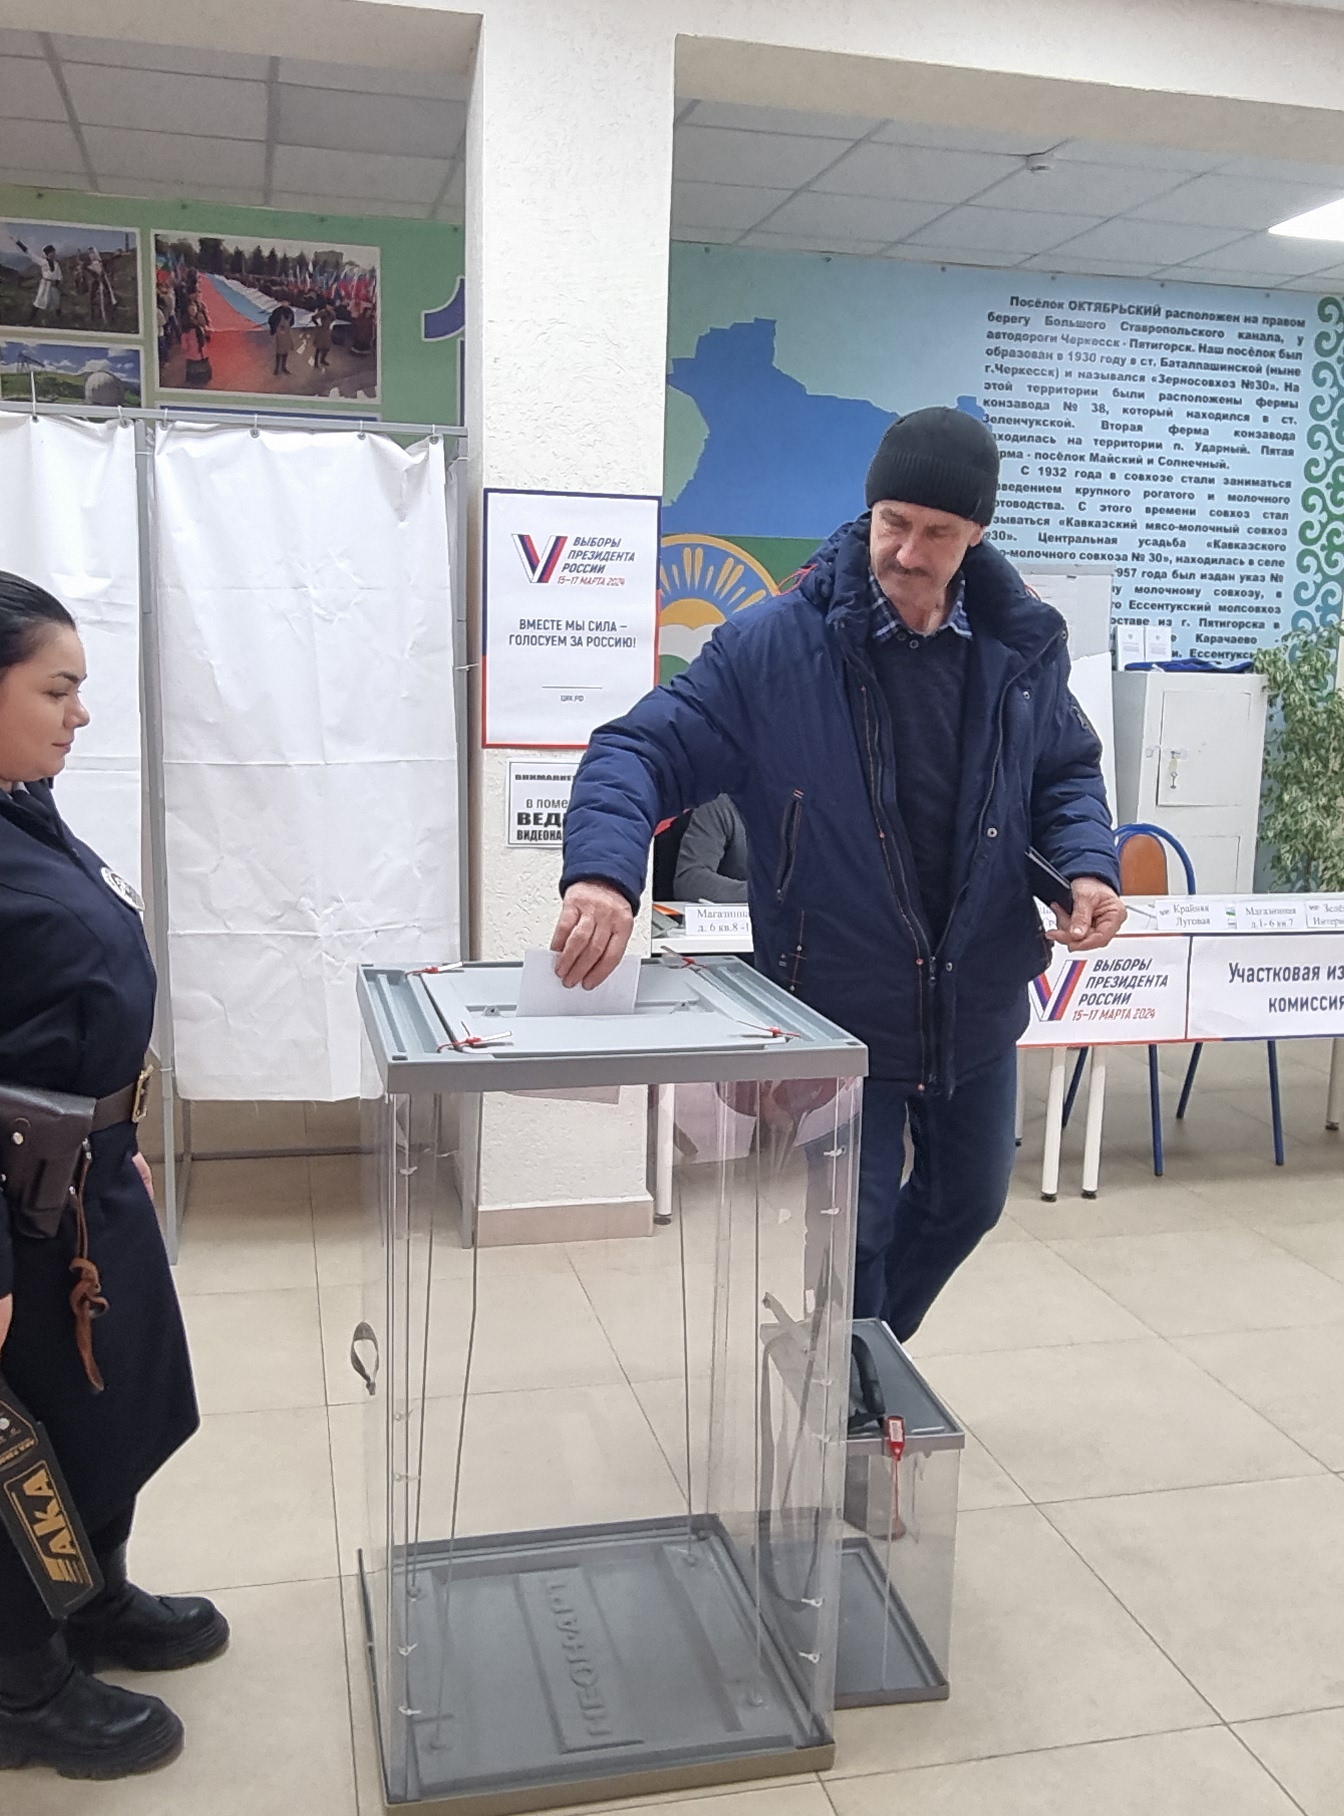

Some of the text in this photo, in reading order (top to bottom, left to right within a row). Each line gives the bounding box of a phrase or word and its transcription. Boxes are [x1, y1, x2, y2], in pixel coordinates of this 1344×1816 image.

[1067, 300, 1162, 318] ОКТЯБРЬСКИЙ
[1164, 309, 1240, 322] расположен
[1261, 316, 1306, 328] правом
[986, 311, 1285, 344] берегу Большого Ставропольского канала,
[985, 330, 1058, 344] автодороги
[1128, 337, 1196, 354] Пятигорск.
[1197, 342, 1224, 354] Наш
[1277, 348, 1303, 360] был
[984, 345, 1301, 378] образован 1930 году Баталпашинской (ныне
[1076, 371, 1146, 382] назывался
[982, 380, 1299, 410] этой территории были расположены фермы
[982, 398, 1250, 422] конзавода который находился
[981, 413, 1296, 442] Зеленчукской. Вторая ферма конзавода
[1092, 437, 1295, 456] территории Ударный. Пятая
[1088, 451, 1144, 466] Майский
[1157, 455, 1230, 470] Солнечный.
[1036, 465, 1292, 488] 1932 года совхозе стали заниматься
[1074, 486, 1291, 506] крупного рогатого молочного
[1098, 504, 1289, 520] этого времени совхоз стал
[1144, 522, 1240, 534] мясо-молочный
[1245, 526, 1288, 536] совхоз
[573, 536, 622, 548] ВЫБОРЫ
[1036, 531, 1118, 546] Центральная
[1137, 536, 1187, 548] усадьба
[567, 549, 635, 562] ПРЕЗИДЕНТА
[1078, 551, 1128, 564] совхоза
[1174, 555, 1246, 566] находилась
[1256, 558, 1286, 568] селе
[561, 563, 606, 574] РОССИИ
[1140, 568, 1266, 584] года был издан указ
[579, 576, 605, 586] МАРТА
[1133, 585, 1265, 600] молочному совхозу,
[1128, 599, 1281, 614] Ессентукский молсовхоз
[519, 618, 562, 631] ВМЕСТЕ
[565, 619, 585, 631] МЫ
[588, 620, 617, 632] СИЛА
[1197, 617, 1265, 630] Пятигорска
[509, 634, 637, 648] ГОЛОСУЕМ ЗА РОССИЮ!
[1194, 632, 1258, 646] Карачаево
[536, 799, 568, 809] ПОМЕ
[517, 811, 563, 828] ВЕД
[516, 829, 563, 842] ВИДЕОНА
[709, 922, 716, 931] 6
[1092, 958, 1153, 972] ВЫБОРЫ
[1228, 961, 1321, 984] Участковая
[1085, 974, 1169, 990] ПРЕЗИДЕНТА
[1077, 992, 1133, 1006] РОССИИ
[1099, 1008, 1131, 1021] МАРТА
[1132, 1007, 1156, 1020] 2024
